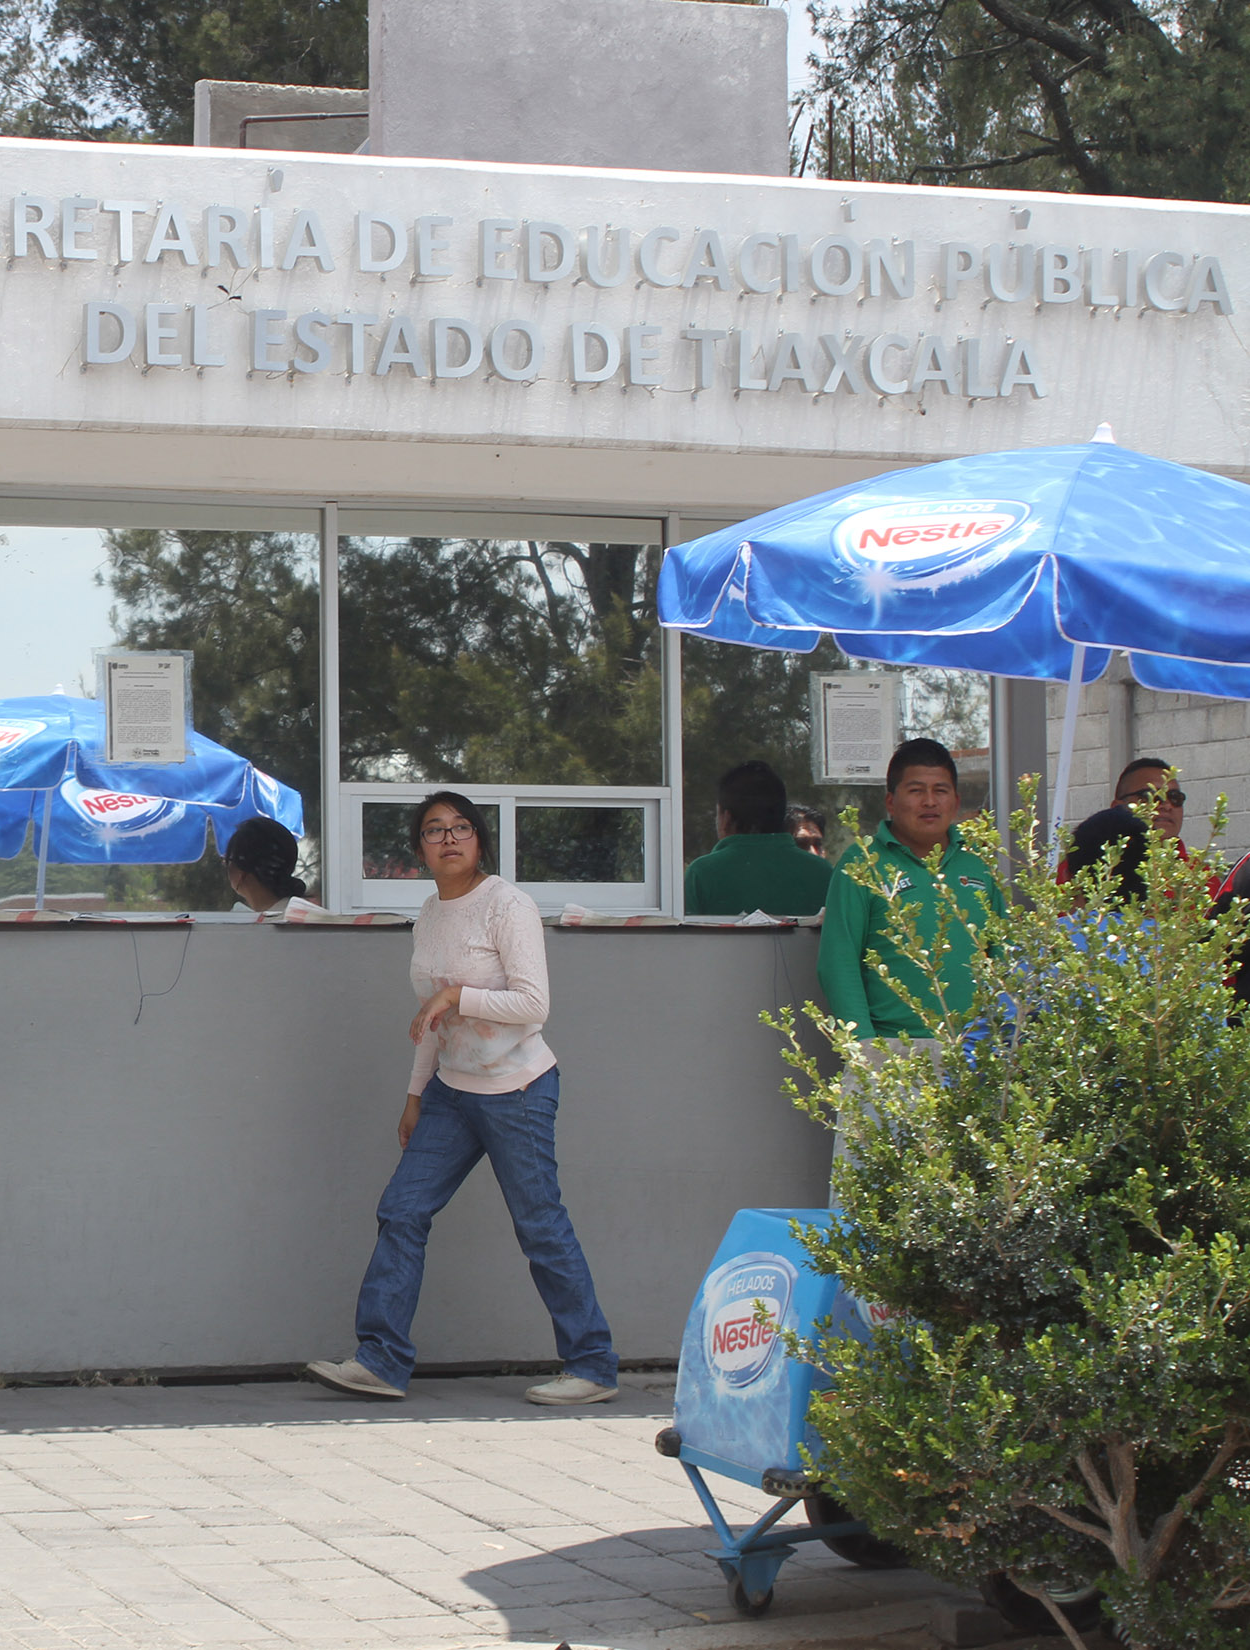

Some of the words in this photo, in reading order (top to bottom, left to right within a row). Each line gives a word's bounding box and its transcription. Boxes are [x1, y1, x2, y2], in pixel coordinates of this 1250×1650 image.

[355, 209, 453, 277] DE
[83, 302, 226, 367] DEL
[252, 308, 546, 382] ESTADO
[570, 322, 664, 386] DE
[680, 327, 1048, 398] TLAXCALA
[726, 1275, 776, 1298] HELADOS
